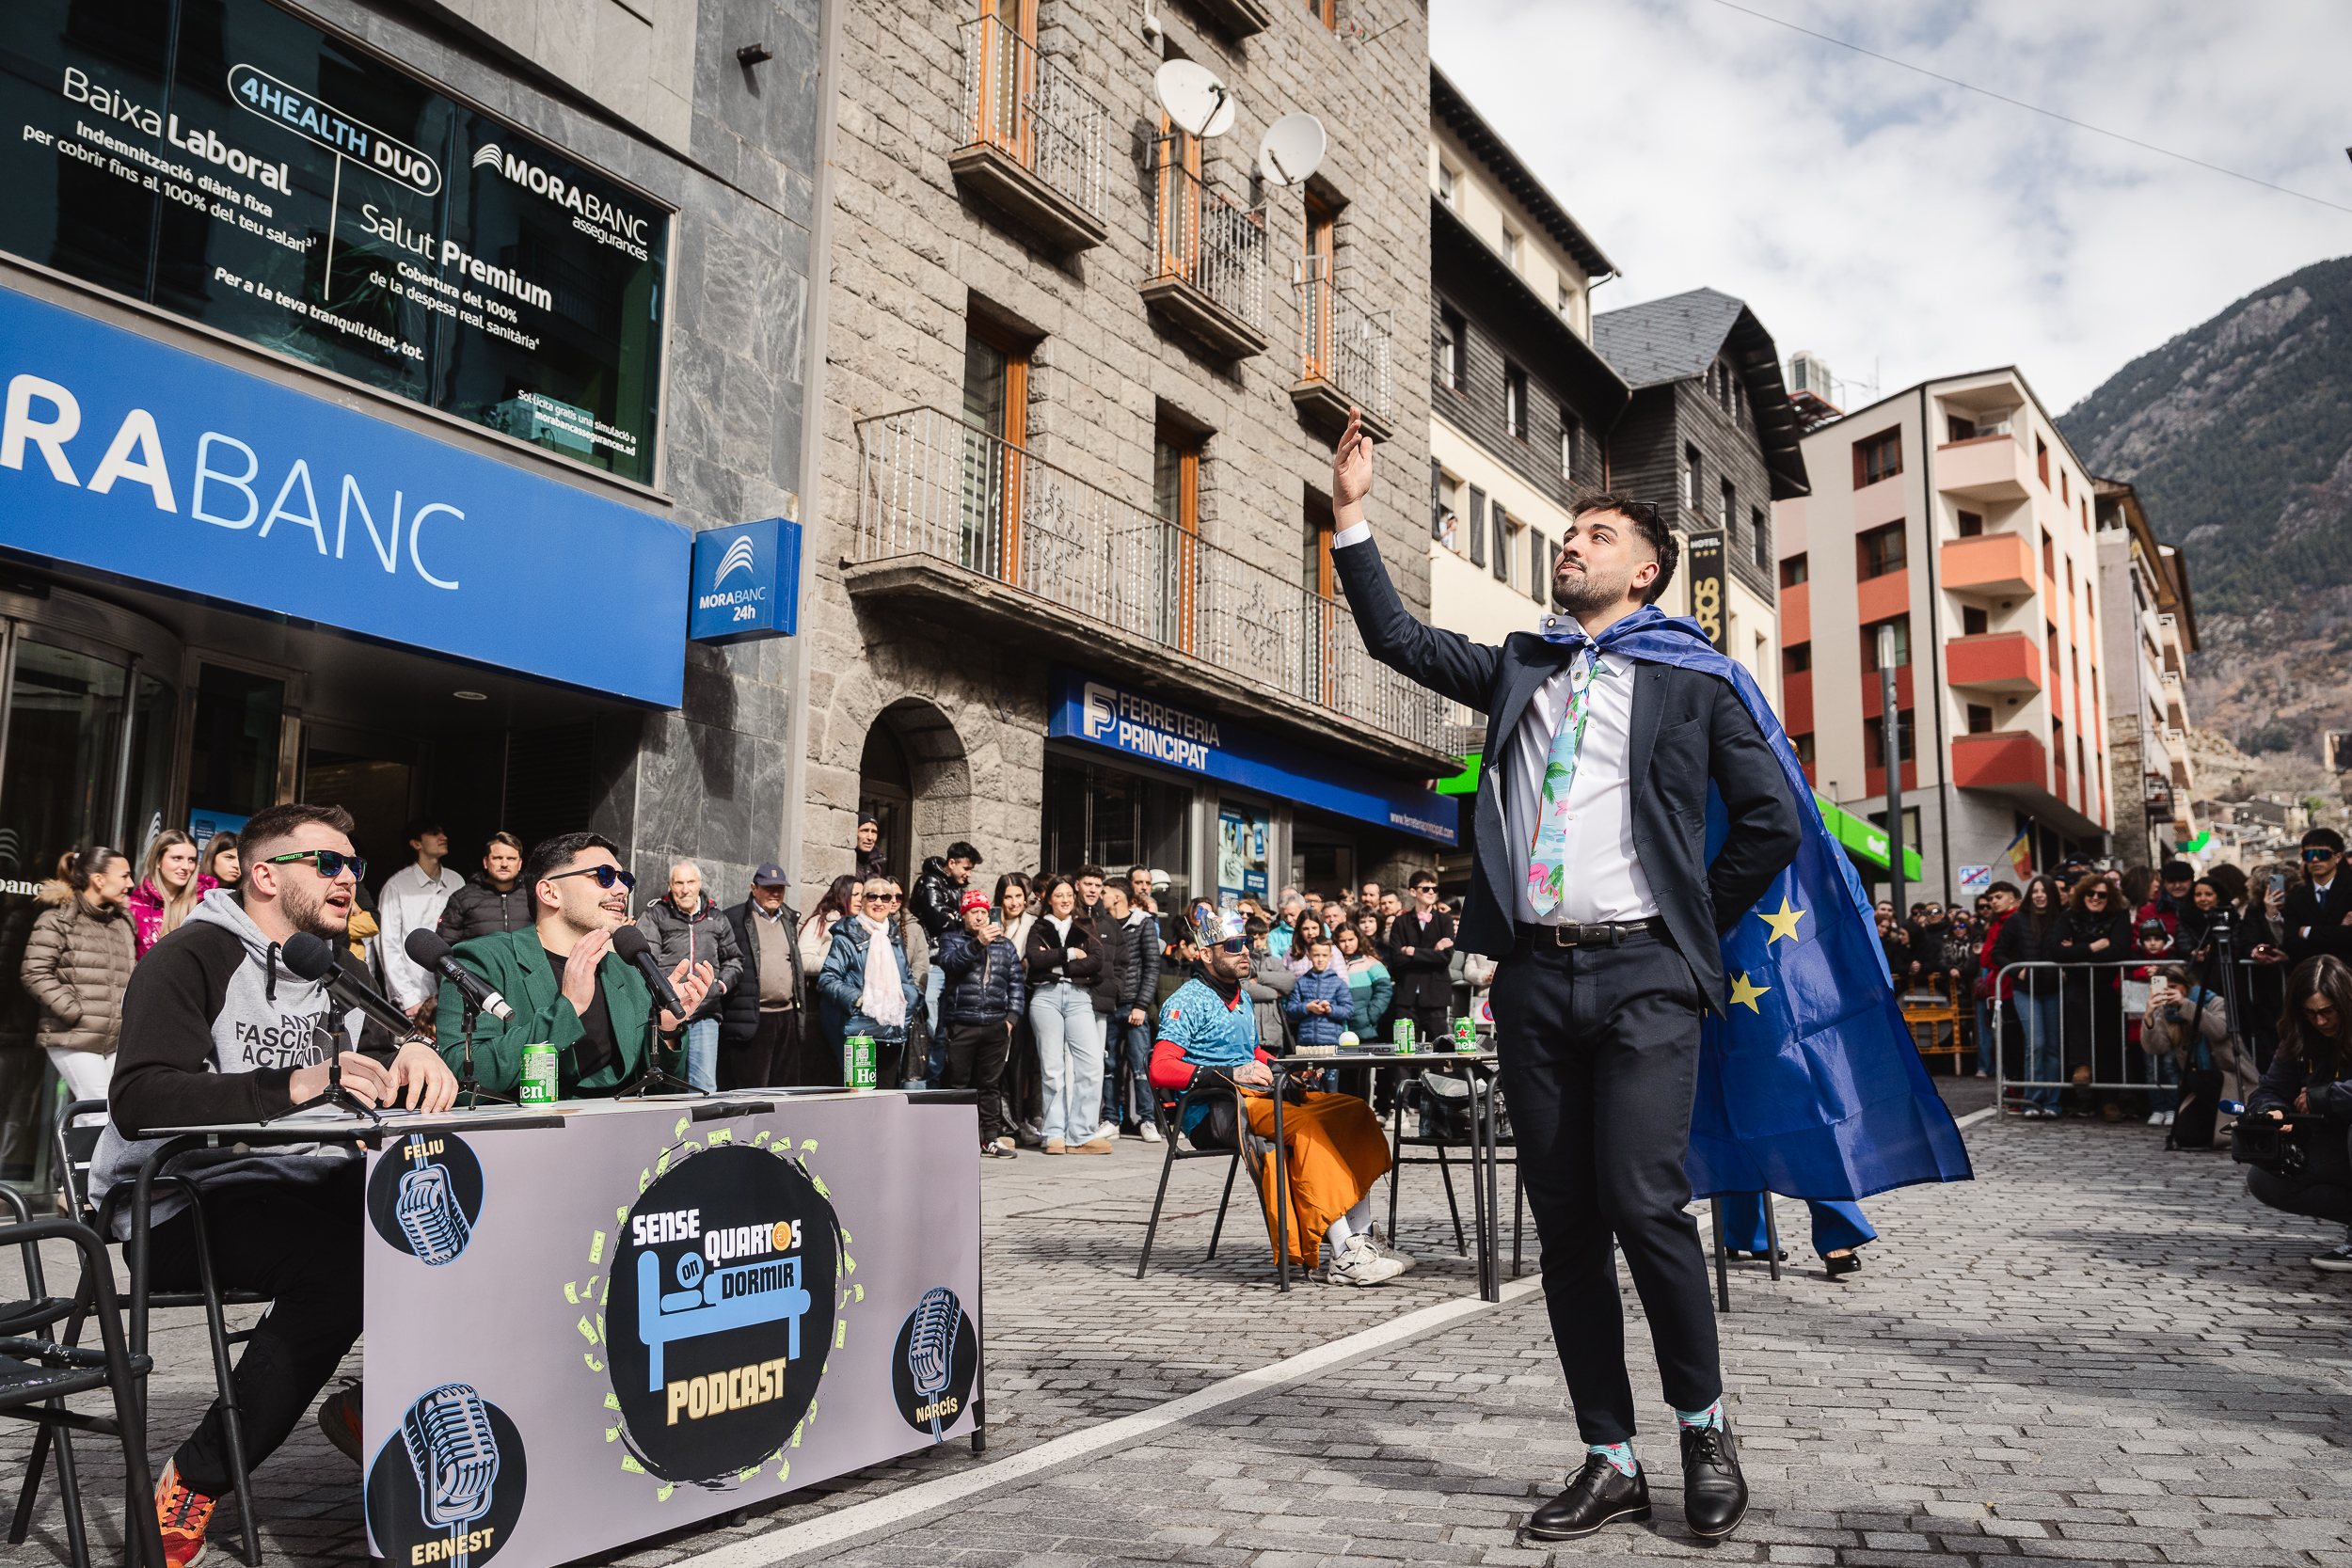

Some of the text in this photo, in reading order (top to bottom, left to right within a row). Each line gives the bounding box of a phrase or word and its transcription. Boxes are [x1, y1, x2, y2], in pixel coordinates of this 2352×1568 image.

[63, 66, 292, 196] Baixa Laboral
[240, 77, 432, 186] 4HEALTH DUO
[23, 124, 55, 146] per
[57, 138, 106, 168] cobrir
[109, 158, 138, 183] fins
[143, 175, 160, 193] al
[163, 181, 207, 213] 100%
[210, 202, 235, 225] del
[238, 213, 263, 236] teu
[76, 120, 273, 218] Indemnització diària fixa
[504, 152, 648, 245] MORABANC
[359, 203, 552, 311] Salut Premium
[572, 215, 648, 261] assegurances
[214, 266, 242, 288] Per
[243, 280, 254, 293] a
[256, 281, 273, 301] la
[275, 290, 308, 315] teva
[401, 341, 424, 361] tot.
[369, 270, 387, 288] de
[389, 277, 404, 295] la
[405, 285, 457, 317] despesa
[459, 309, 485, 329] real
[397, 261, 518, 324] Cobertura del 100%
[534, 410, 636, 457] morabancassegurances.ad
[578, 415, 594, 428] una
[594, 420, 630, 442] simulació
[630, 435, 637, 445] a
[1690, 537, 1721, 549] HOTEL
[699, 586, 766, 610] MORABANC
[733, 604, 756, 622] 24h
[1120, 691, 1220, 747] FERRETERIA
[1119, 721, 1209, 771] PRINCIPAT
[520, 1085, 544, 1099] en
[404, 1138, 444, 1161] FELIU
[632, 1208, 701, 1247] SENSE
[722, 1261, 795, 1300] DORMIR
[667, 1356, 787, 1426] PODCAST
[915, 1395, 958, 1423] NARCÍS
[412, 1527, 494, 1566] ERNEST
